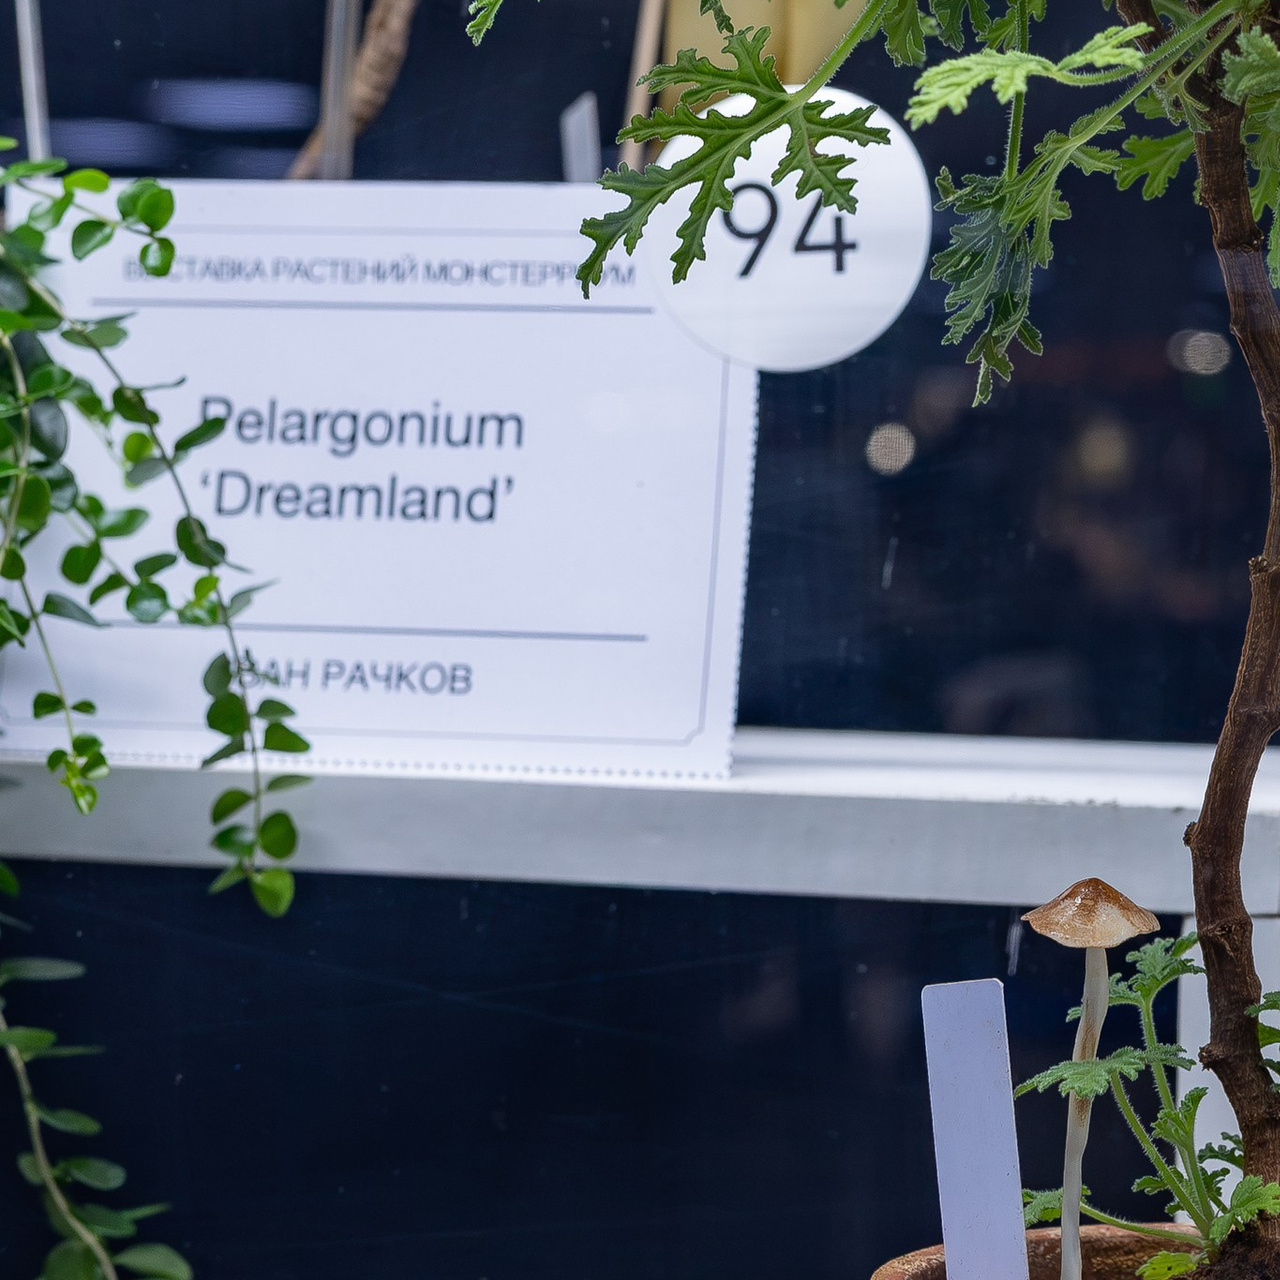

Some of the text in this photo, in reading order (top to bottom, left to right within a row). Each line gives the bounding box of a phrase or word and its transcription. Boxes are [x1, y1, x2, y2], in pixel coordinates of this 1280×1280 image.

[722, 183, 858, 277] 94
[123, 253, 638, 288] ВТАВКА РАСТЕНИЙ МОНСТЕРРУМ
[200, 396, 524, 458] Pelargonium
[228, 657, 473, 695] ВАН РАЧКОВ
